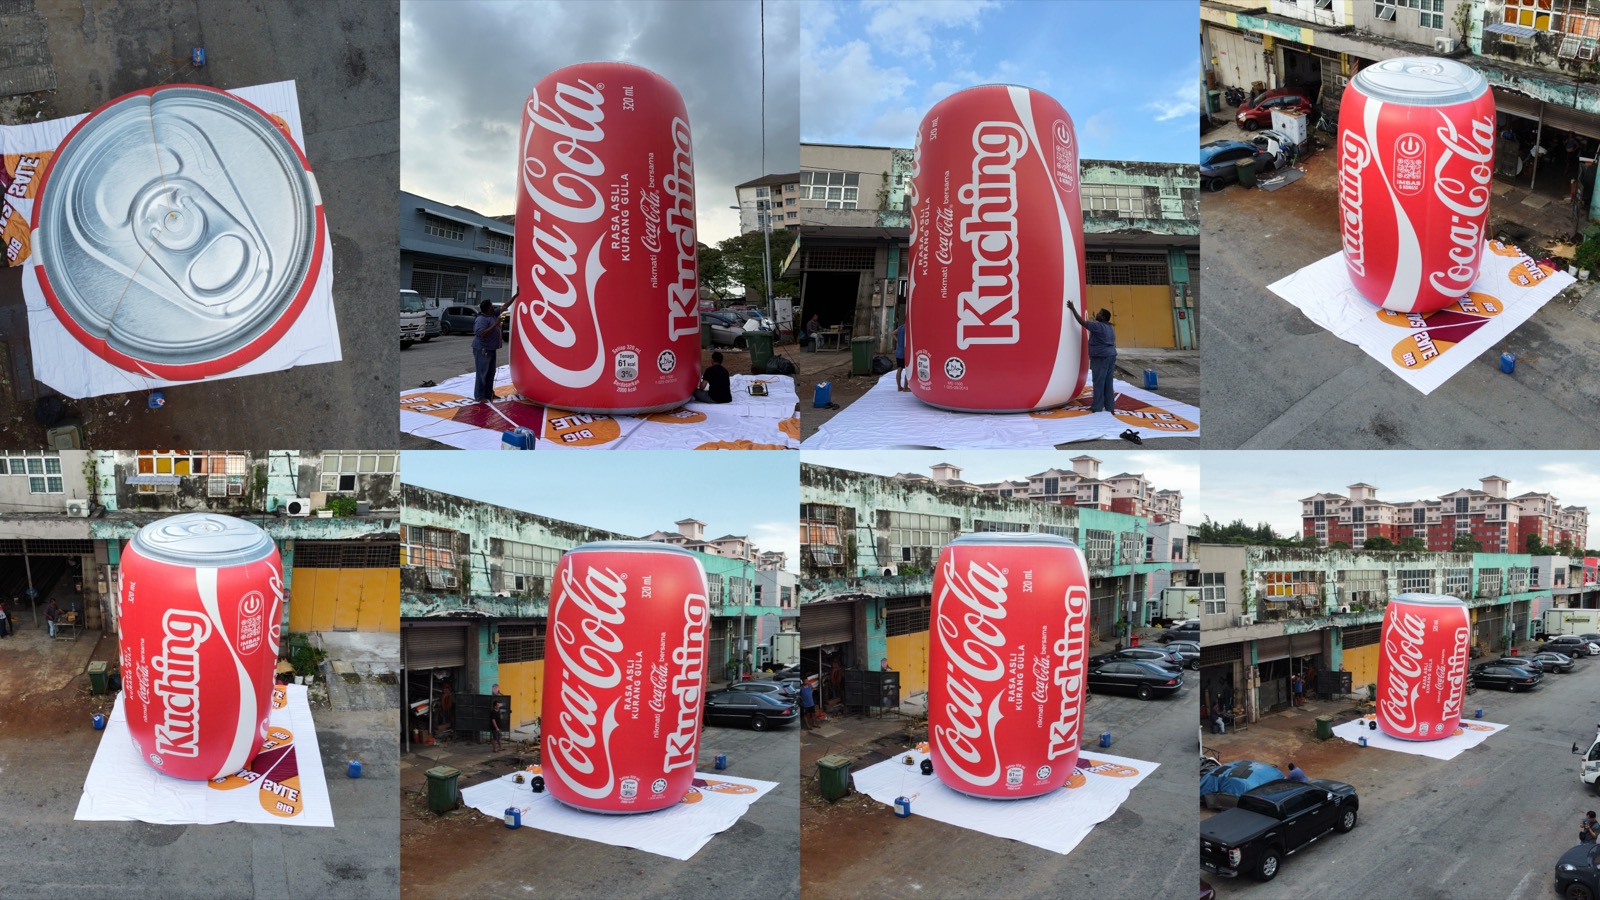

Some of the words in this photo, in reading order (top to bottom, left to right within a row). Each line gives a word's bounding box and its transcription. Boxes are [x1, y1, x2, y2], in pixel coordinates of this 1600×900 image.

[622, 85, 634, 97] mL
[622, 97, 635, 112] 320
[930, 128, 938, 141] 320
[611, 183, 620, 211] ASLI
[620, 173, 629, 204] GULA
[1339, 129, 1372, 278] Kuching
[1429, 108, 1494, 298] Coca-Cola
[517, 78, 606, 389] Coca-Cola
[611, 215, 620, 249] RASA
[621, 209, 630, 261] KURANG
[640, 186, 661, 253] Coca-Cola
[663, 116, 699, 343] Kuching
[934, 205, 954, 266] Coca-Cola
[957, 120, 1029, 351] Kuching
[650, 254, 658, 288] nikmati
[1482, 302, 1498, 313] BIG
[618, 359, 626, 367] 61
[621, 370, 633, 378] 3%
[613, 379, 640, 388] Berdasarkan
[560, 428, 595, 443] BIG
[642, 575, 652, 585] mL
[1023, 569, 1033, 580] mL
[1023, 580, 1033, 593] 320
[641, 584, 652, 598] 320
[240, 636, 260, 647] IMBAS
[659, 631, 667, 662] bersama
[625, 659, 634, 680] ASLI
[634, 650, 643, 677] GULA
[934, 548, 1009, 787] Coca-Cola
[1009, 653, 1018, 674] ASLI
[1017, 644, 1025, 671] GULA
[1380, 605, 1426, 734] Coca-Cola
[136, 660, 151, 704] Coca-Cola
[153, 608, 213, 758] Kuching
[547, 556, 629, 800] Coca-Cola
[648, 662, 668, 713] Coca-Cola
[664, 593, 709, 774] Kuching
[1031, 654, 1050, 703] Coca-Cola
[1048, 586, 1089, 761] Kuching
[1442, 627, 1469, 722] Kuching
[624, 683, 632, 711] RASA
[632, 680, 642, 719] KURANG
[1008, 677, 1016, 702] RASA
[1015, 672, 1024, 711] KURANG
[653, 713, 661, 739] nikmati
